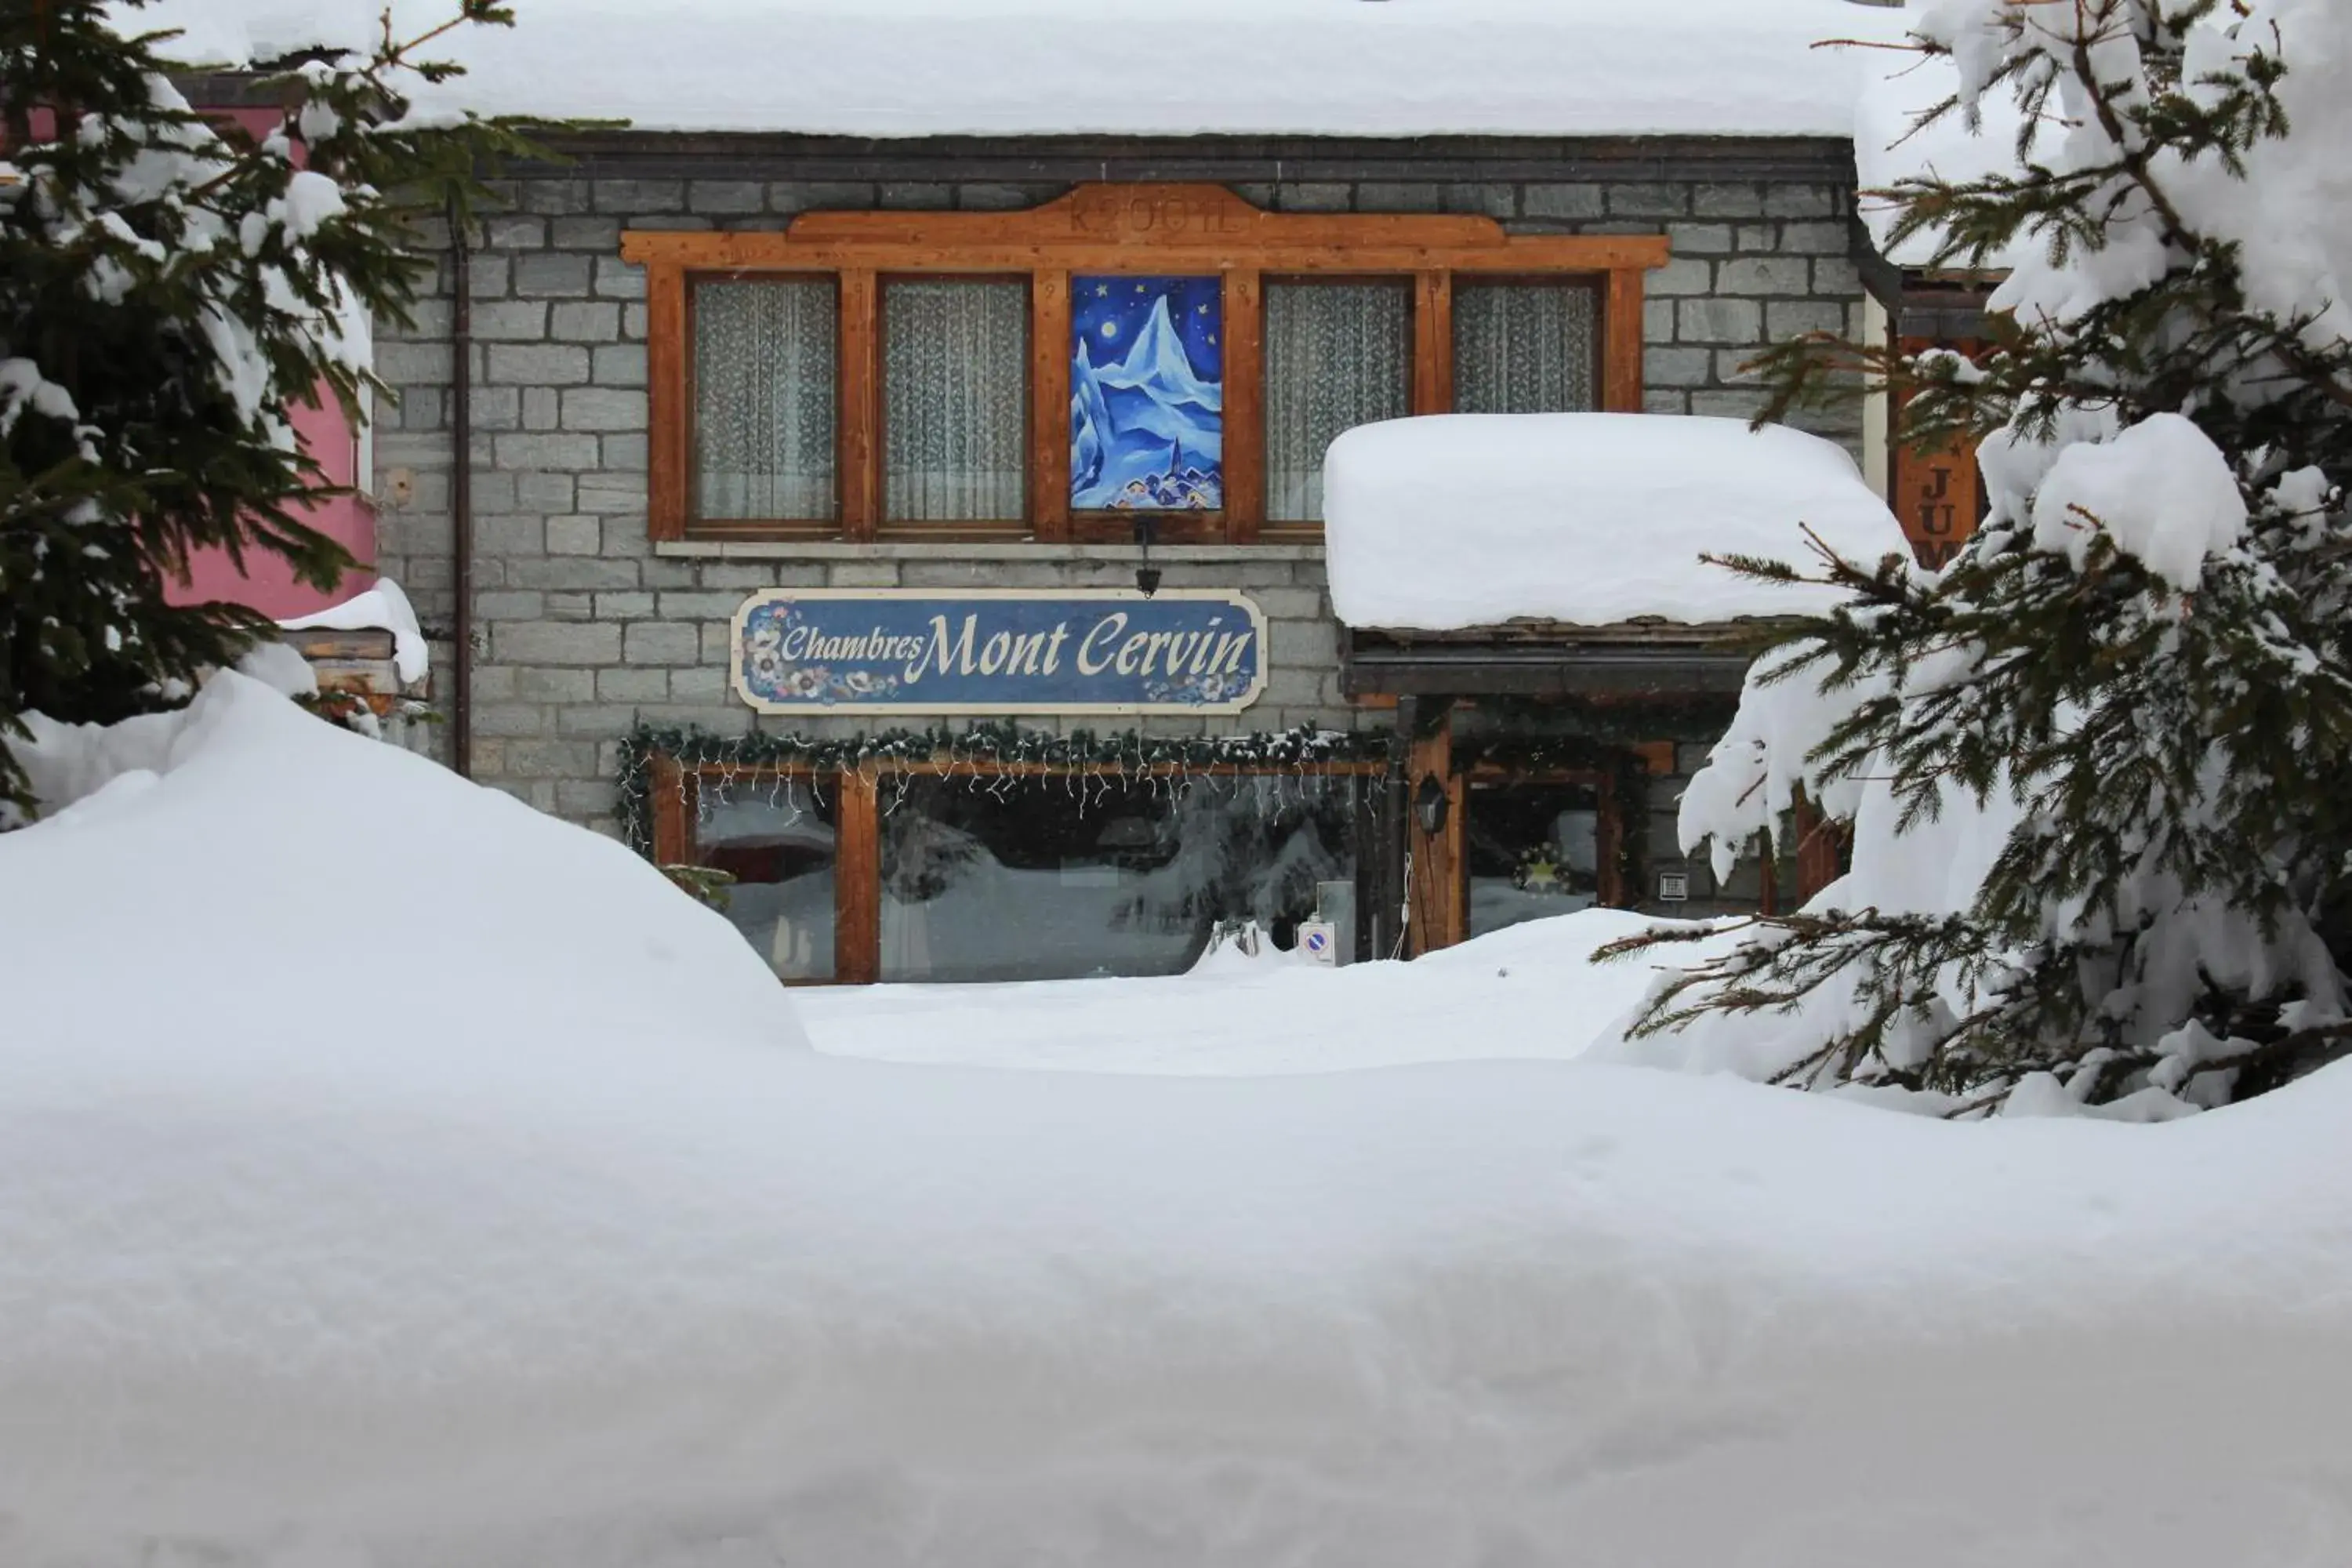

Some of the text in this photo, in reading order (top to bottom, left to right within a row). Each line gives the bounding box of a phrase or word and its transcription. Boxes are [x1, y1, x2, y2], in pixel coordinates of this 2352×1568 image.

[782, 612, 1253, 684] Chambres Mont Cervin
